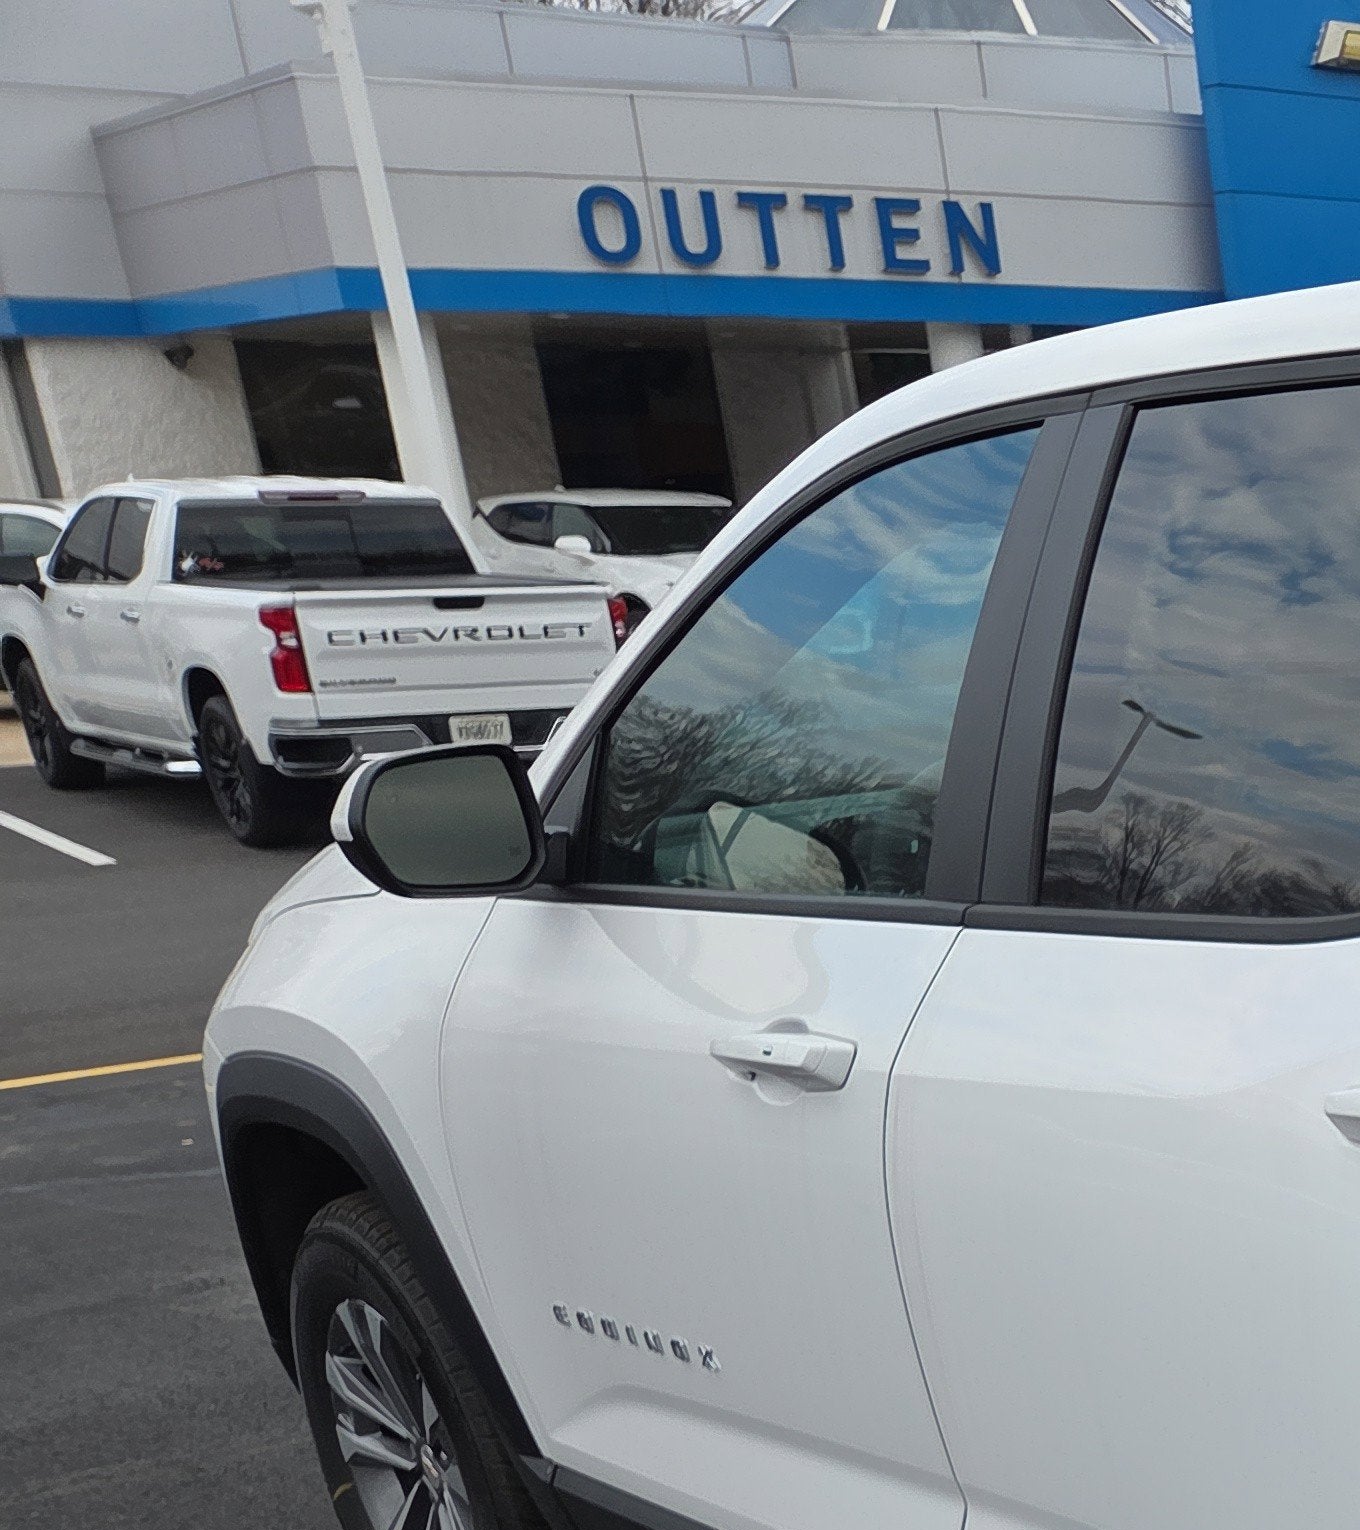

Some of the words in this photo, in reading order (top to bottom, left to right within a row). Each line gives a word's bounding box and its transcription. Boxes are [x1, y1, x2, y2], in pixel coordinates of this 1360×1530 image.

[577, 185, 1001, 277] OUTTEN
[326, 622, 592, 647] CHEVROLET
[552, 1301, 722, 1372] EQUINOX
